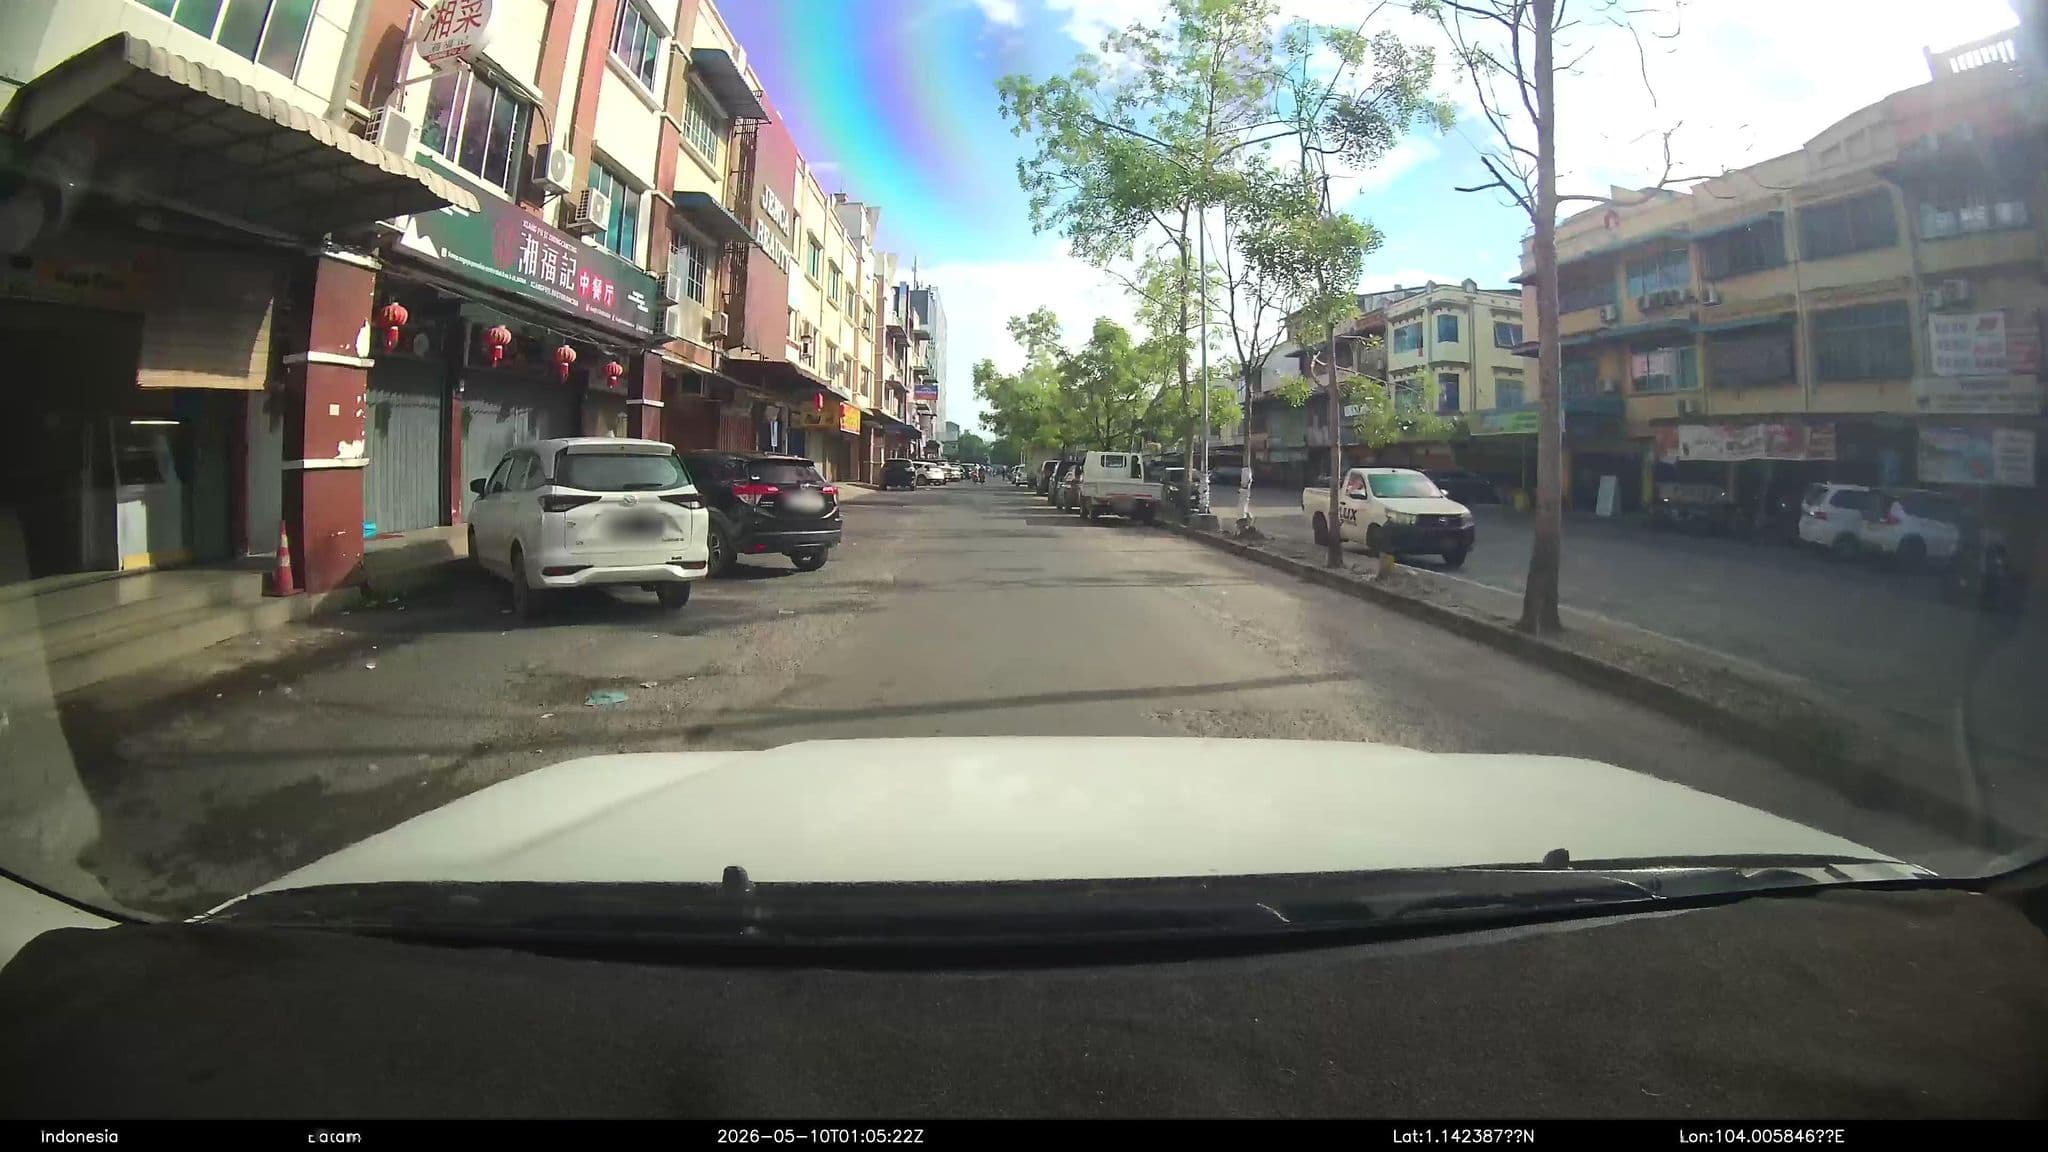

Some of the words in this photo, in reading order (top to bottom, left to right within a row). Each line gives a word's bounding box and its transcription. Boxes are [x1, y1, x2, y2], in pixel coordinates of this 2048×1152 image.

[518, 232, 577, 291] 湘福記
[580, 271, 615, 306] 中餐厅
[757, 217, 792, 274] BEAUTY
